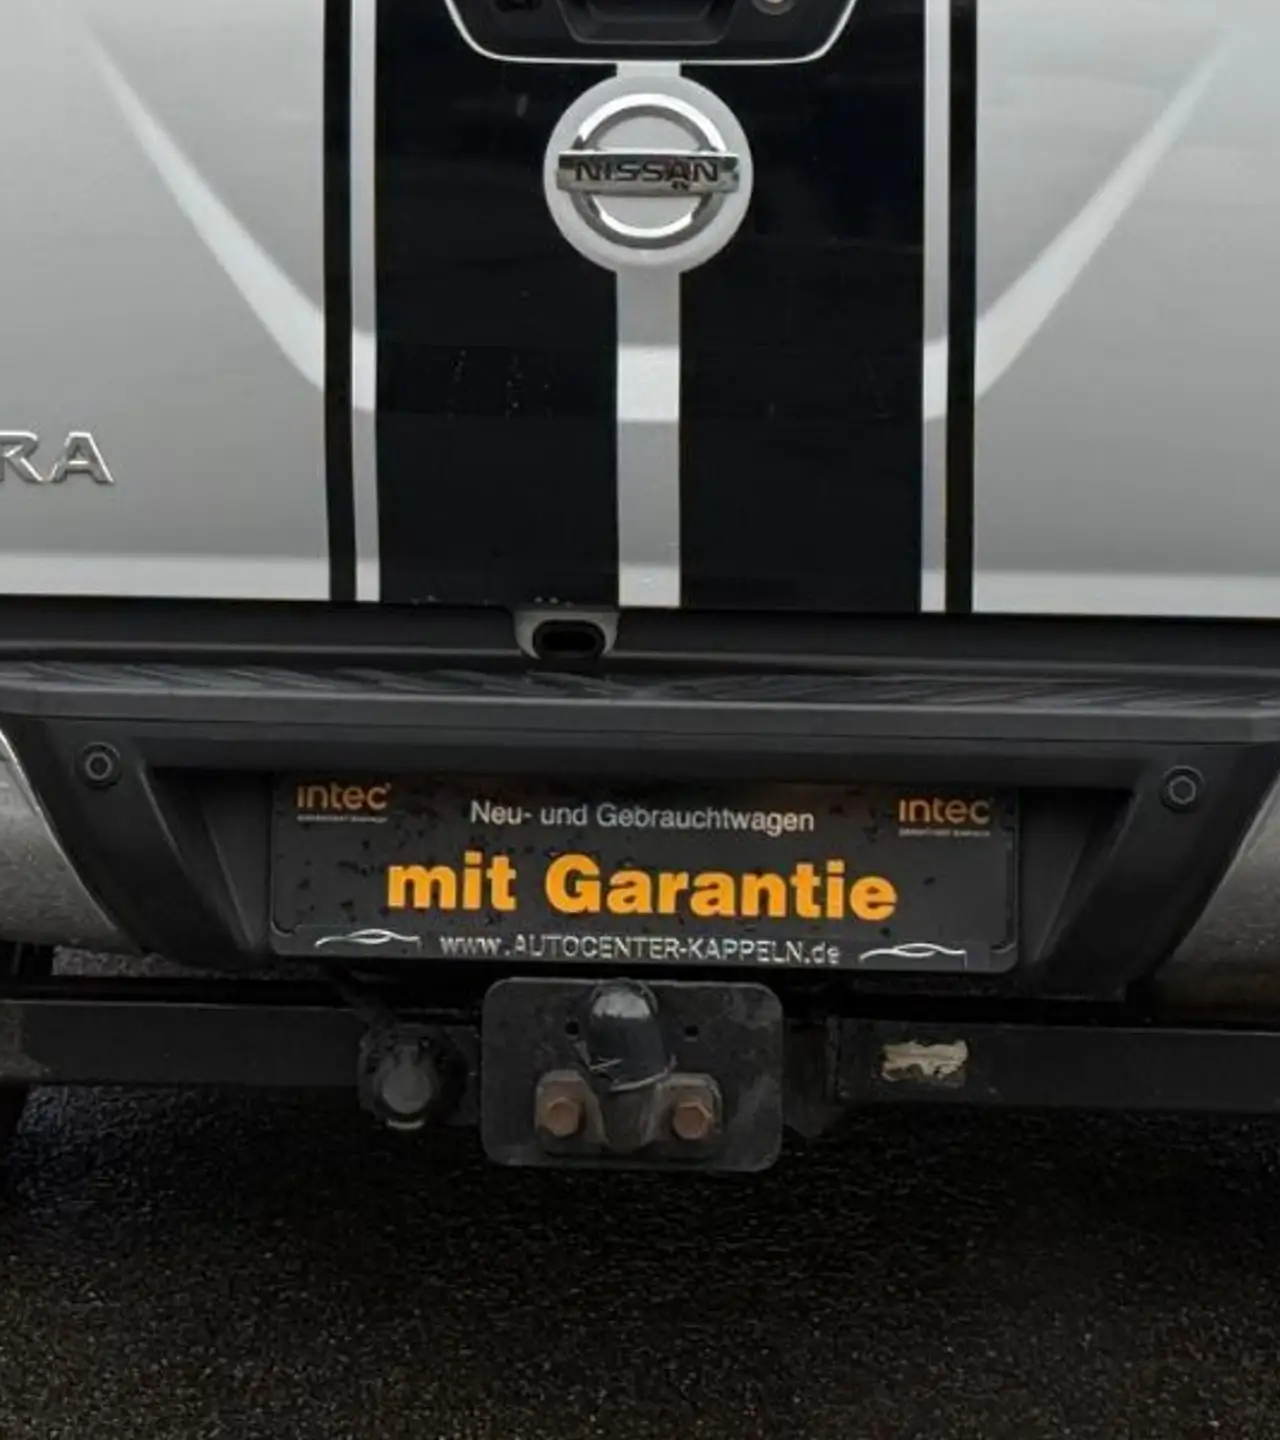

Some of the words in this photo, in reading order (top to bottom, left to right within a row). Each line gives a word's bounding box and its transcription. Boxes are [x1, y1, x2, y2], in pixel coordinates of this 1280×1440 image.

[575, 160, 719, 182] NISSAN
[297, 783, 391, 810] intec
[899, 798, 990, 825] intec
[470, 800, 531, 827] Neu-
[541, 802, 587, 827] und
[596, 802, 814, 837] Gebrauchtwagen
[387, 850, 516, 910] mit
[545, 853, 898, 921] Garantie
[440, 933, 841, 966] www.AUTOCENTER-KAPPELN.de
